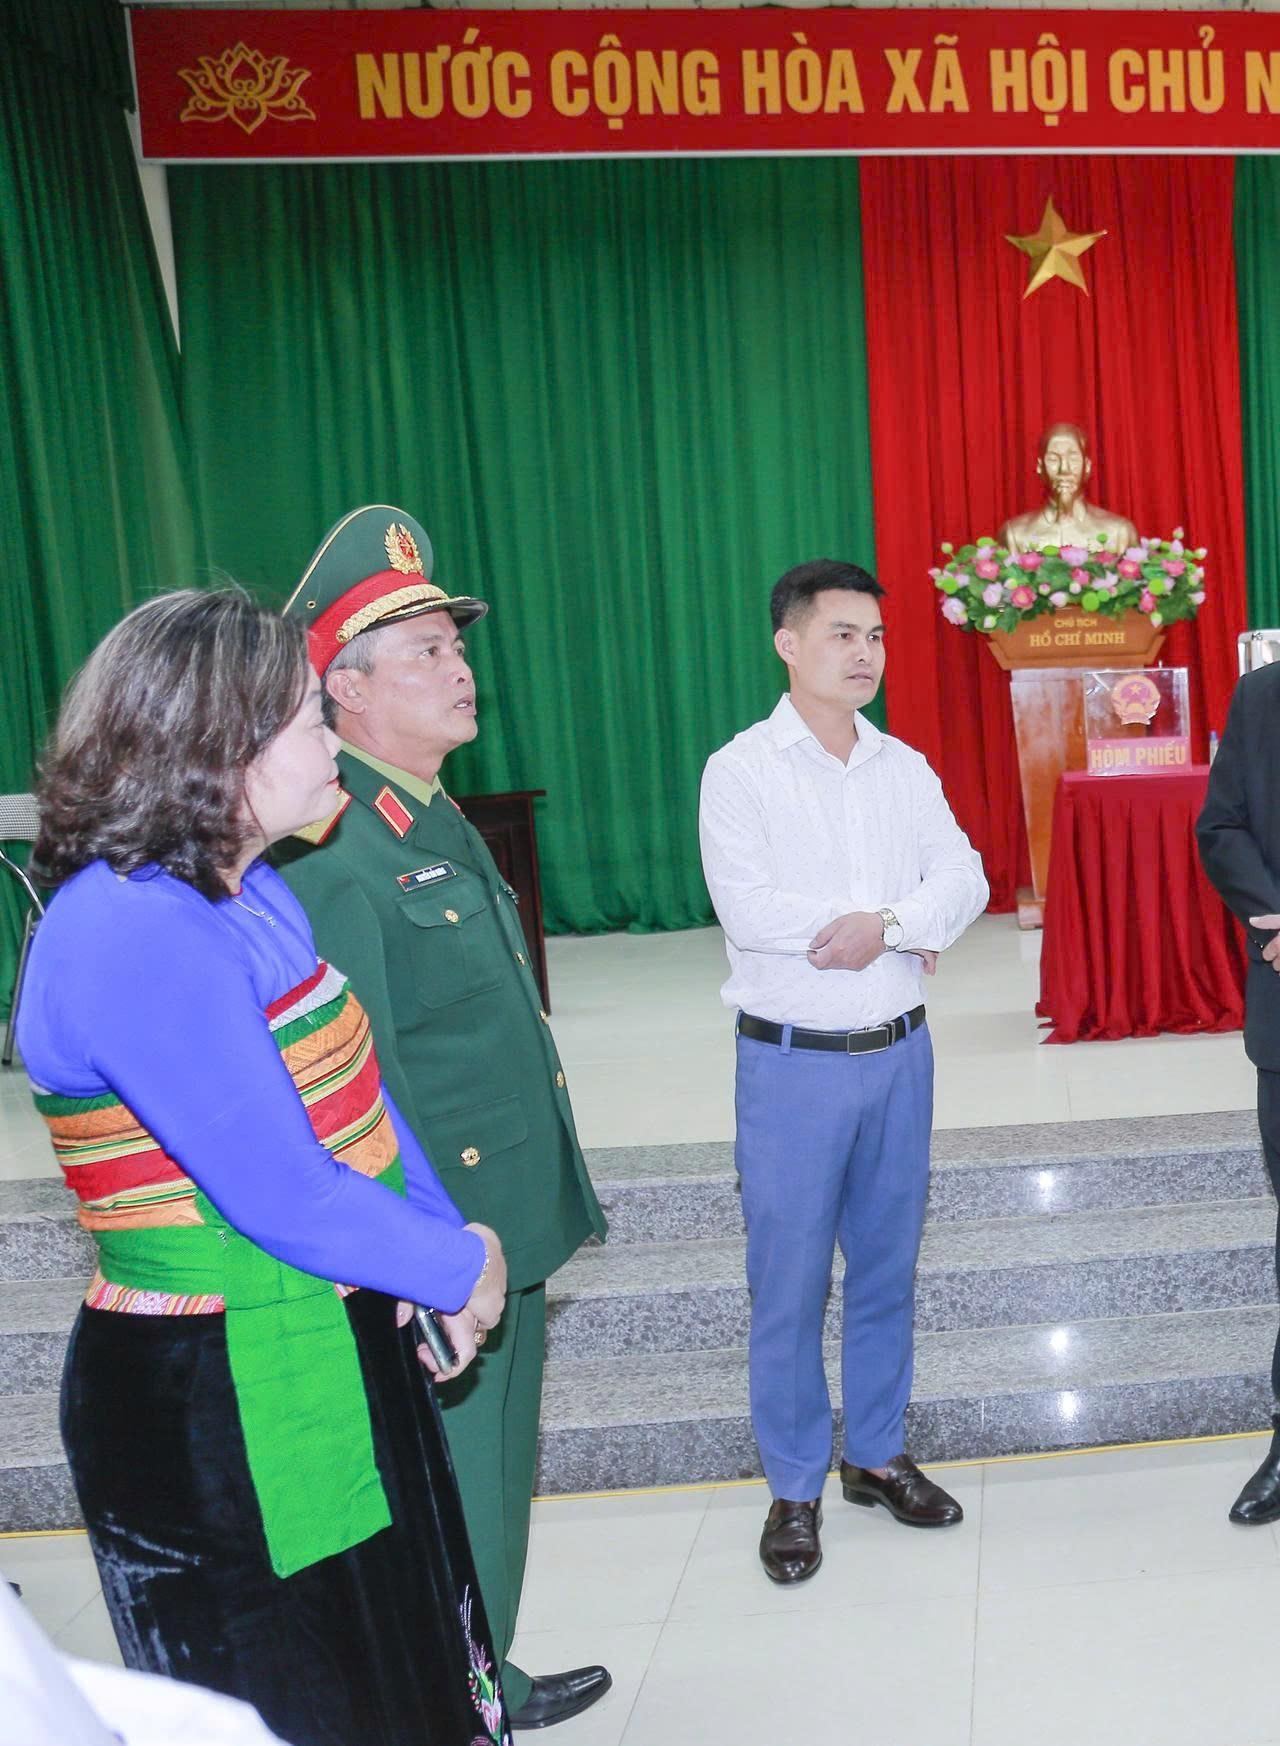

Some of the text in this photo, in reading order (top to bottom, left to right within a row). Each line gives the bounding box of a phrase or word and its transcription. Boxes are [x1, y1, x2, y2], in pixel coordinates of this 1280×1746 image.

[355, 28, 531, 119] NƯỚC
[551, 34, 720, 130] CỘNG
[743, 32, 864, 115] HÒA
[885, 34, 969, 114] XÃ
[990, 33, 1087, 126] HỘI
[1108, 26, 1225, 114] CHỦ
[1029, 630, 1127, 647] HỒ CHÍ MINH
[1135, 740, 1187, 766] PHIẾU
